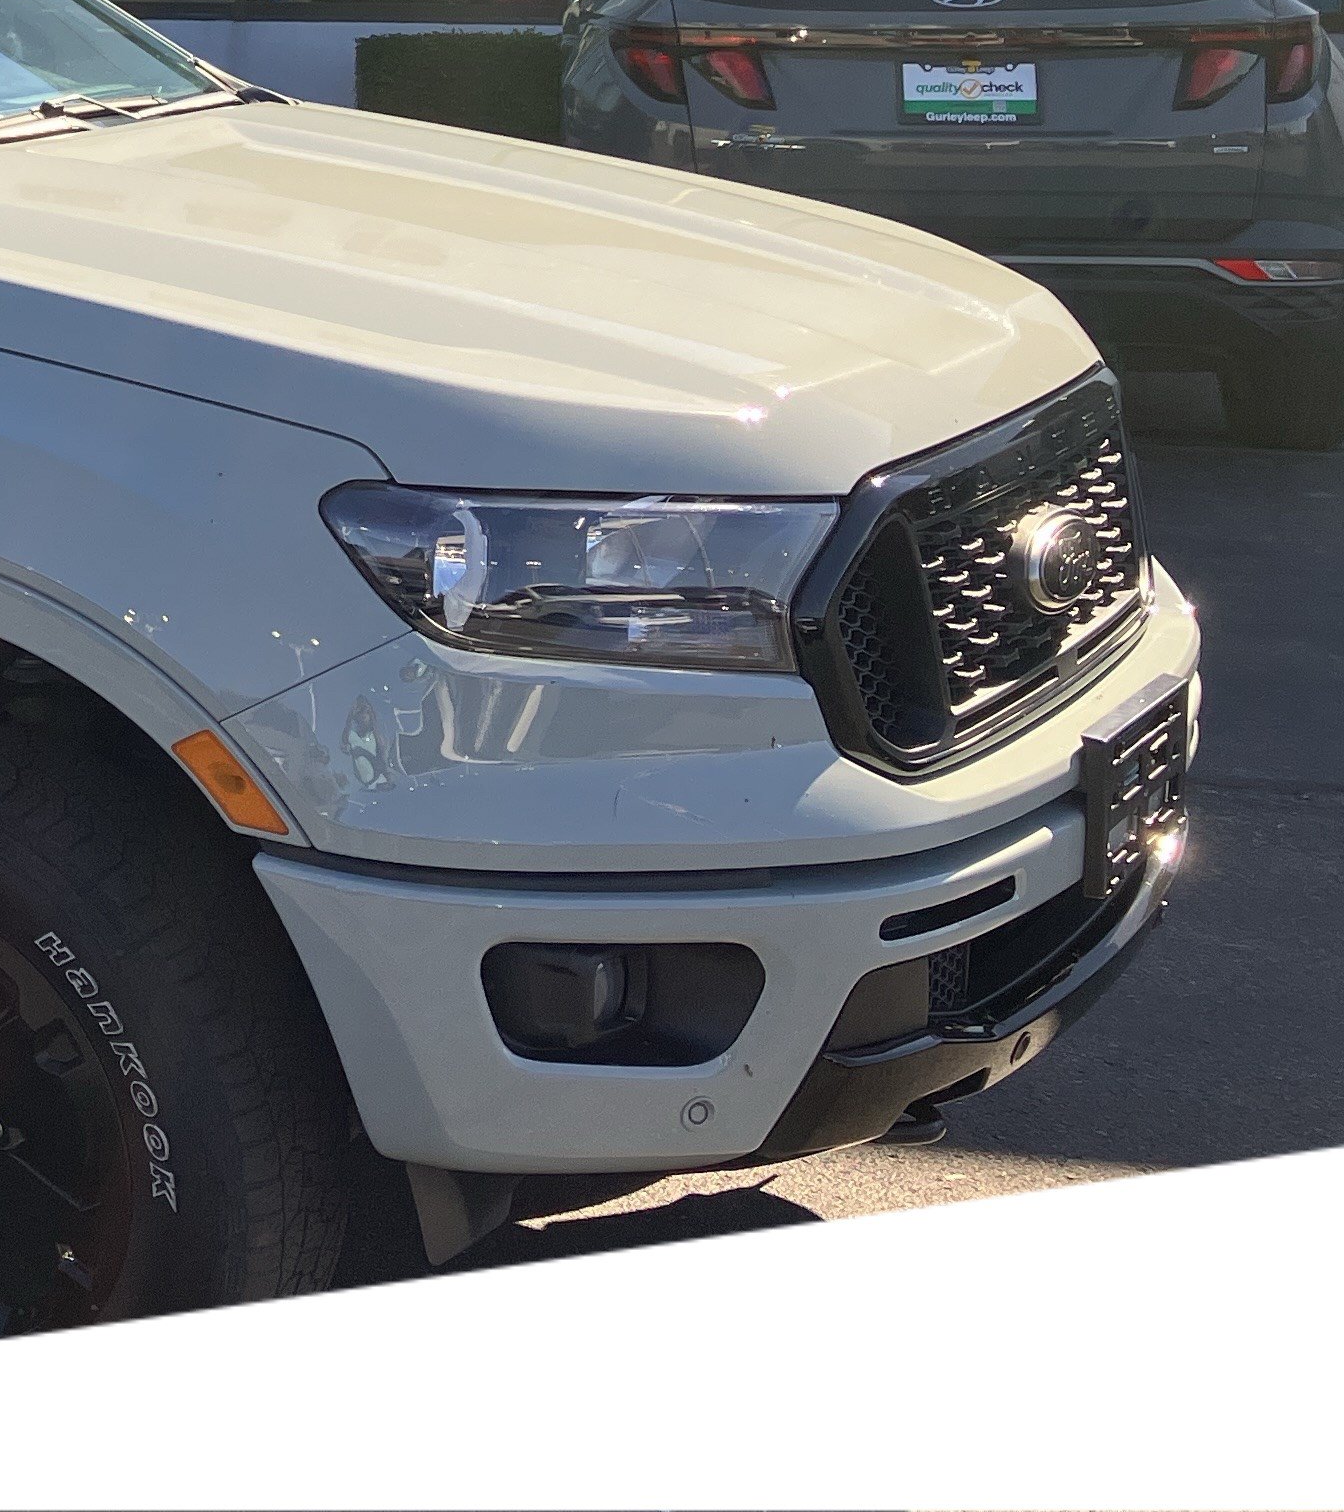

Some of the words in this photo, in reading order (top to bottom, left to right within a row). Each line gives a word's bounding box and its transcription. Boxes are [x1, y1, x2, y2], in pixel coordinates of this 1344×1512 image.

[916, 81, 963, 96] quality
[981, 81, 1024, 93] check
[925, 111, 1017, 124] Gurleyleep.com
